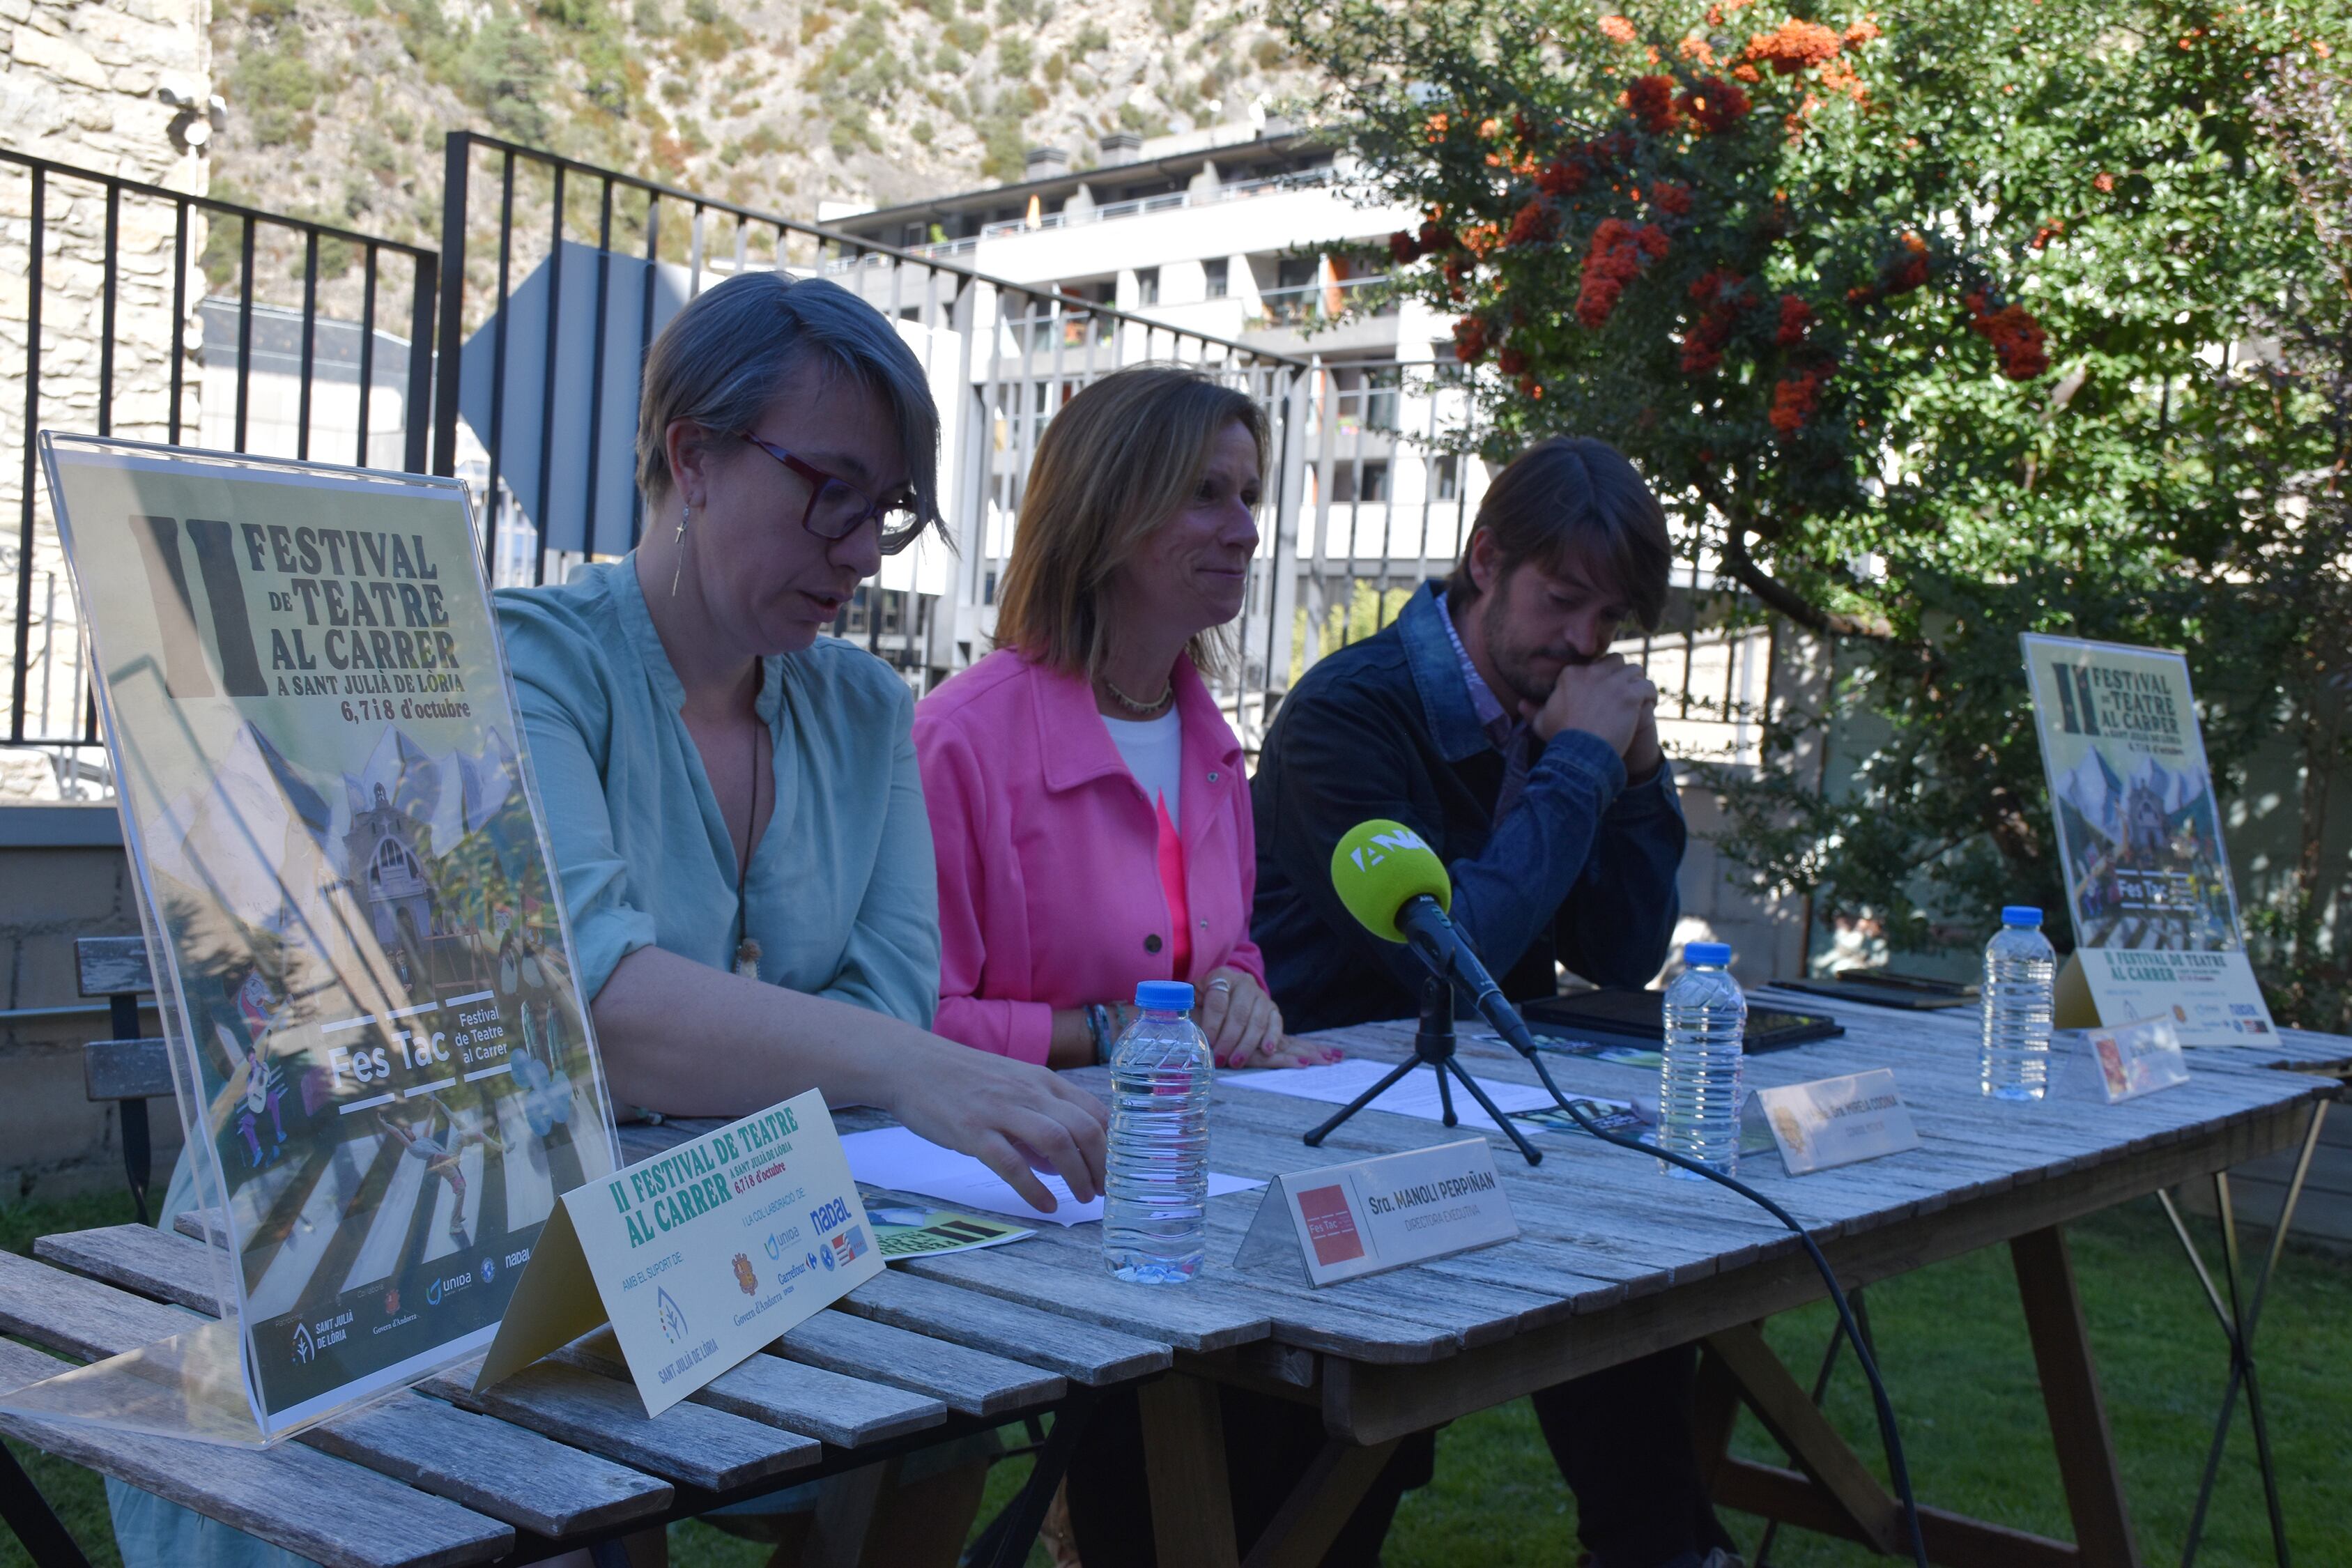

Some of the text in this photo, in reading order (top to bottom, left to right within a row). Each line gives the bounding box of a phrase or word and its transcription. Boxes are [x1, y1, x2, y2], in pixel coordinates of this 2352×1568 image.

[240, 523, 437, 579] FESTIVAL
[268, 578, 449, 627] DE TEATRE
[272, 629, 459, 670] AL CARRER
[277, 670, 465, 695] A SANT JULIÀ DE LÒRIA
[2092, 668, 2171, 694] FESTIVAL
[401, 698, 471, 719] d'octubre
[2110, 691, 2176, 716] TEATRE
[2102, 711, 2119, 728] AL
[459, 1006, 499, 1027] Festival
[455, 1027, 504, 1047] de Teatre
[328, 1030, 450, 1088] Fes Tac
[463, 1043, 507, 1063] al Carrer
[609, 1106, 799, 1213] II FESTIVAL DE TEATRE
[735, 1161, 750, 1178] SANT
[756, 1162, 786, 1183] d'octubre
[1369, 1171, 1496, 1215] Sra. MANOLI PERPIÑAN
[625, 1172, 733, 1249] AL CARRER
[1309, 1224, 1323, 1233] Fes
[1323, 1221, 1338, 1229] Tac
[622, 1275, 638, 1292] AMB
[637, 1271, 647, 1284] EL
[646, 1256, 672, 1278] SUPORT
[778, 1262, 806, 1285] Carrefour
[316, 1309, 354, 1335] SANT JULIÀ
[733, 1292, 783, 1327] Govern d'Andorra
[373, 1313, 417, 1335] Govern d'Andorra
[316, 1330, 347, 1349] DE LÒRIA
[658, 1338, 719, 1384] SANT JULIÀ DE LÒRIA
